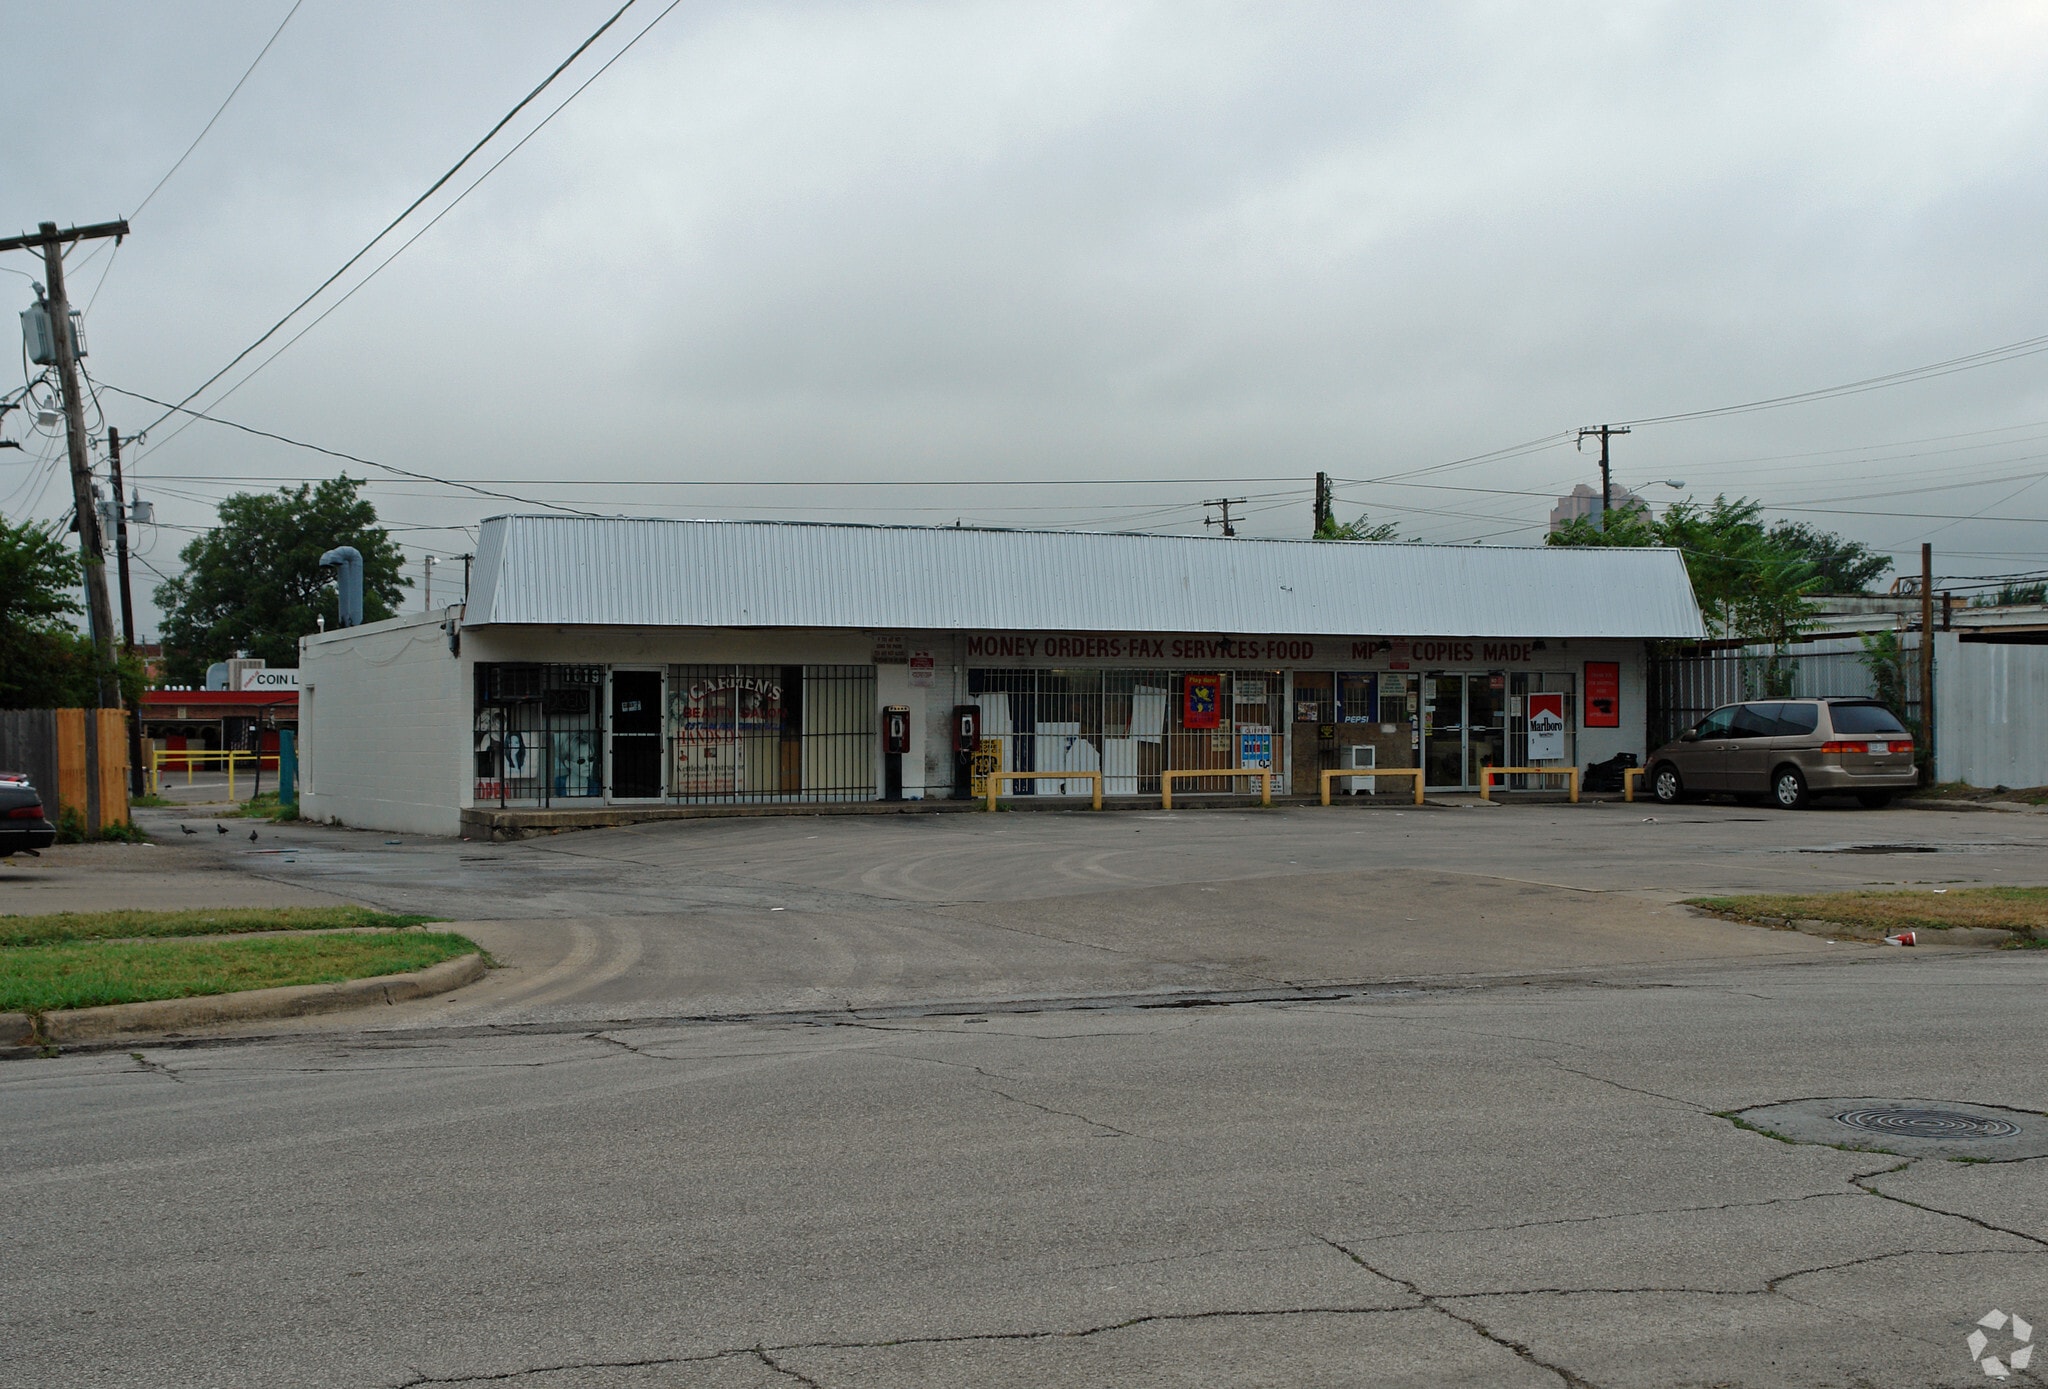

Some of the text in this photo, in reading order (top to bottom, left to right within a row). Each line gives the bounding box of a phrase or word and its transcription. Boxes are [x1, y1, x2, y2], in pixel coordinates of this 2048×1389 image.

[968, 636, 1313, 659] MONEY ORDERS FAX SERVICES FOOD
[1412, 642, 1473, 660] COPIES
[1484, 643, 1531, 661] MADE
[257, 674, 288, 685] COIN
[565, 668, 600, 683] 1019
[690, 674, 782, 700] CARMEN'S
[683, 707, 788, 719] BEAUTY SALON
[1344, 715, 1369, 723] PEPSI
[1530, 717, 1563, 732] Marlboro
[476, 782, 511, 799] OPEN
